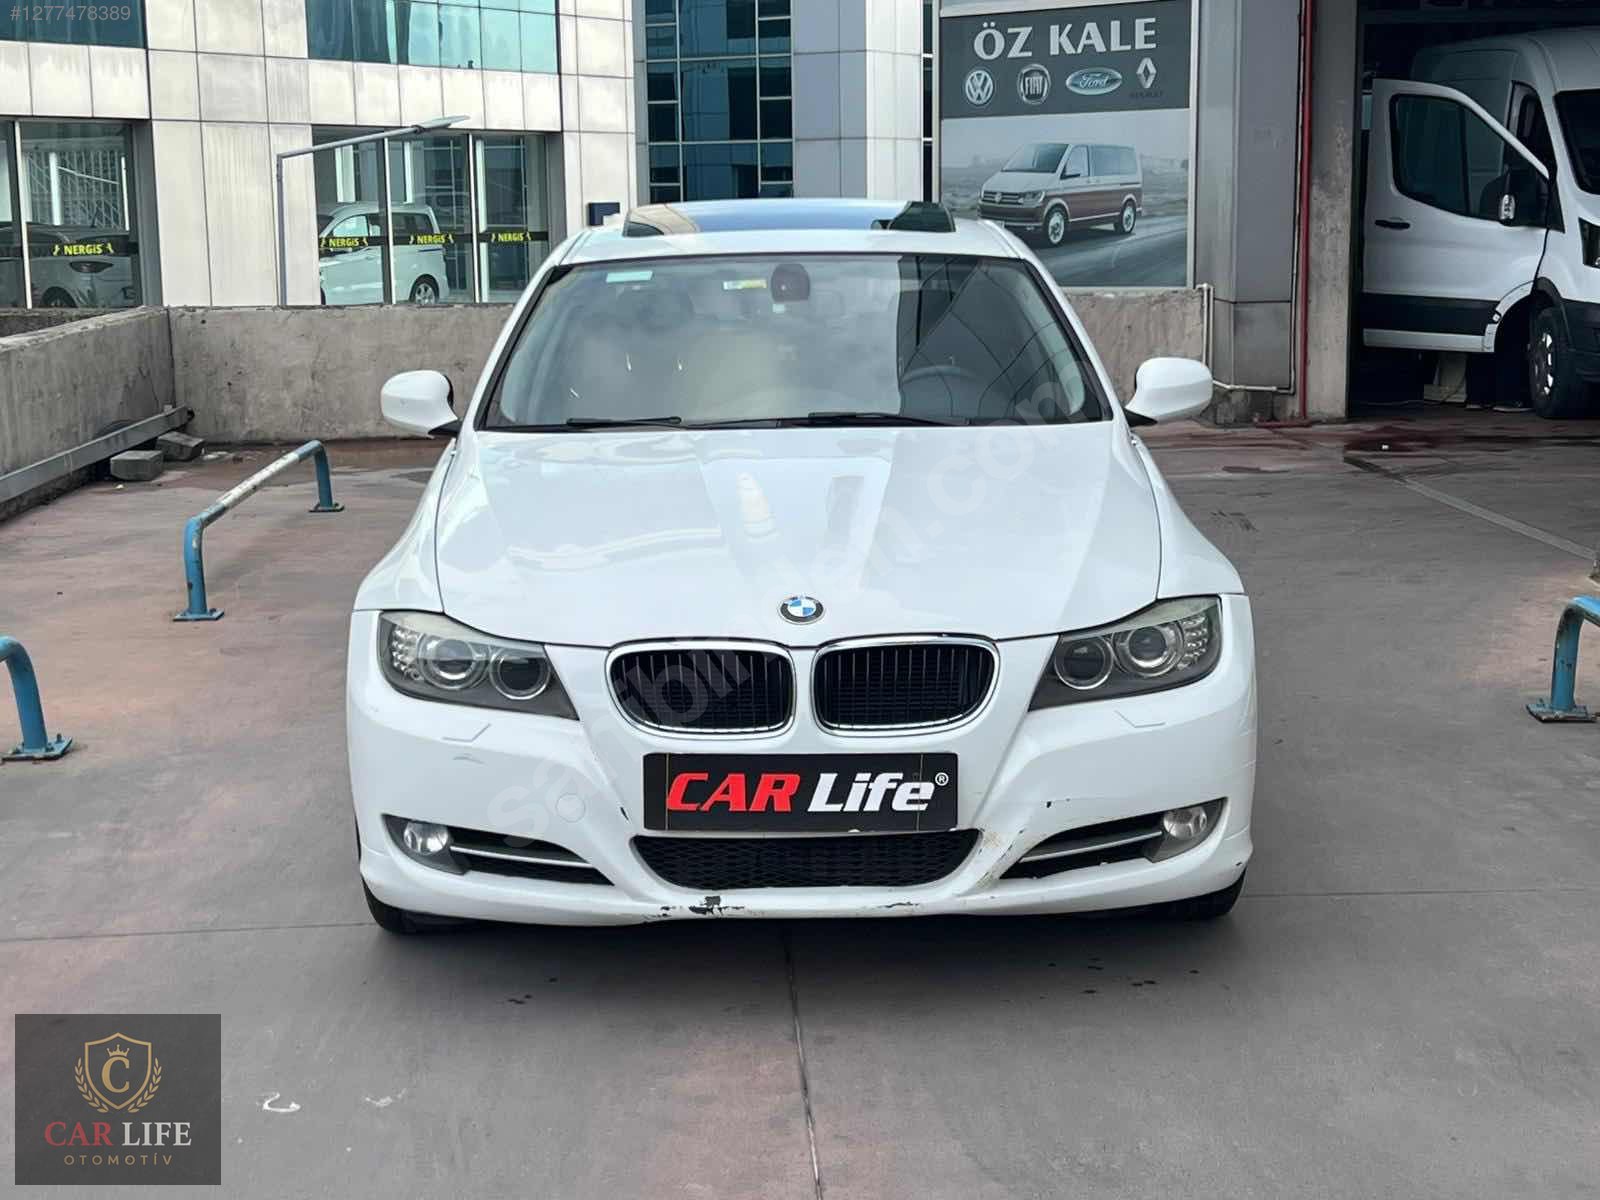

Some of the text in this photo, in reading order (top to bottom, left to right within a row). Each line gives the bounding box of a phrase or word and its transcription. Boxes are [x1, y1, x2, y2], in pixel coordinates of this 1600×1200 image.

[973, 17, 1156, 60] ÖZ KALE
[666, 772, 801, 812] CAR
